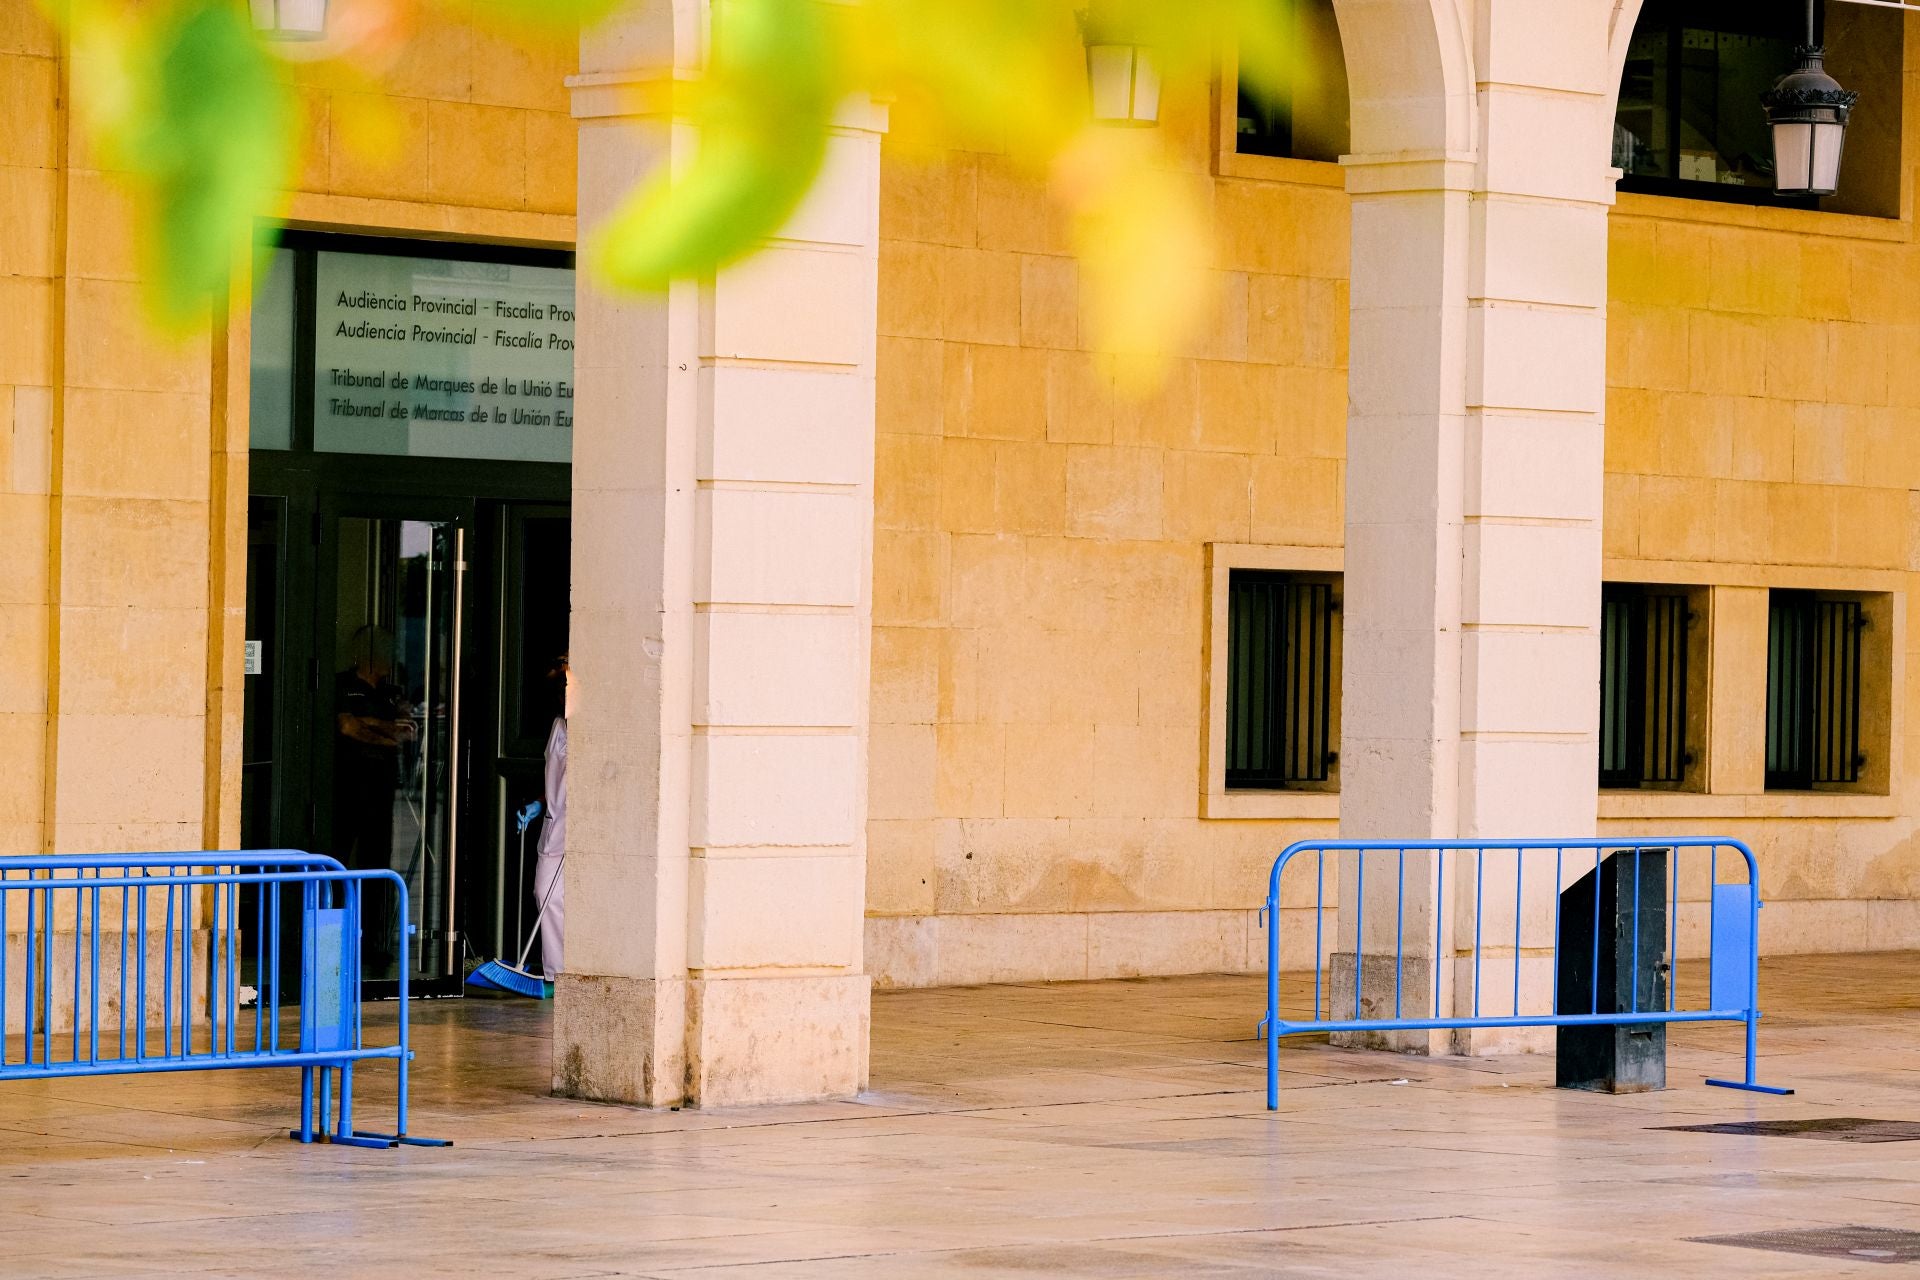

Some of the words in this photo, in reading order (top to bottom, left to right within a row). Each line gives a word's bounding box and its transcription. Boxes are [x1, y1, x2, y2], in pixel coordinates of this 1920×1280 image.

[338, 291, 406, 311] Audiència
[413, 296, 477, 315] Provincial
[496, 301, 543, 319] Fiscalia
[336, 320, 405, 341] Audiencia
[413, 325, 476, 344] Provincial
[495, 330, 542, 349] Fiscalía
[332, 369, 385, 388] Tribunal
[391, 372, 409, 389] de
[416, 374, 475, 396] Marques
[481, 377, 498, 395] de
[505, 378, 516, 395] la
[524, 380, 552, 397] Unió
[330, 399, 384, 418] Tribunal
[391, 402, 408, 419] de
[414, 405, 465, 422] Marcas
[471, 405, 488, 423] de
[495, 407, 506, 424] la
[513, 409, 550, 426] Unión
